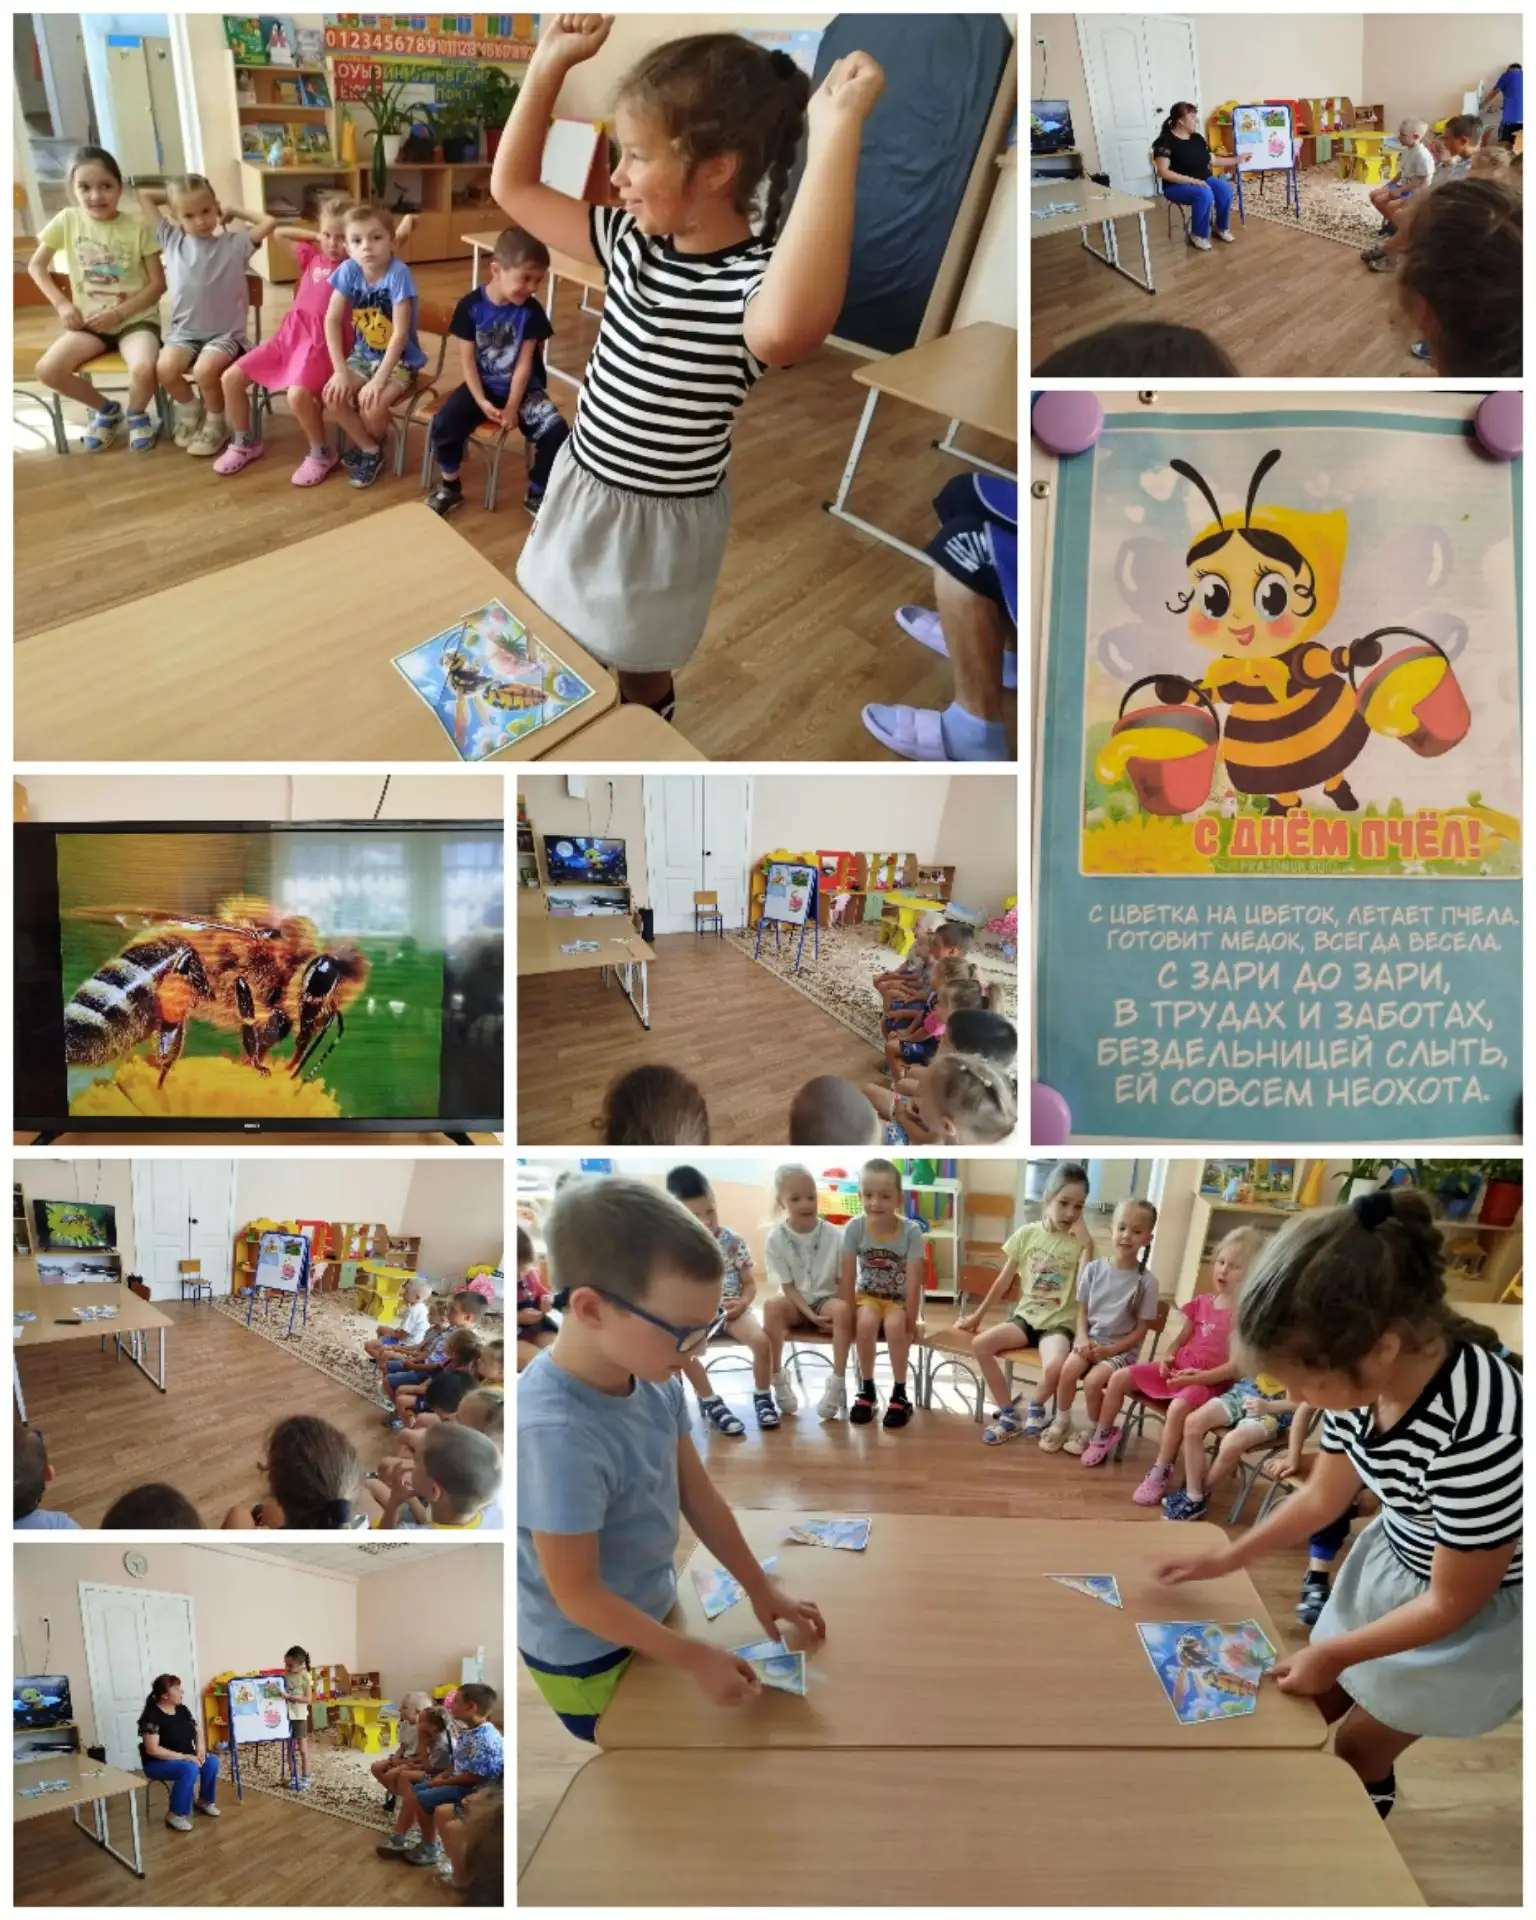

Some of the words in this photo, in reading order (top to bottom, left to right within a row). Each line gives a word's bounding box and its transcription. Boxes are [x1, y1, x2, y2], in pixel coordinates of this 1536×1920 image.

[1194, 817, 1220, 855] С
[1230, 809, 1349, 857] ДНЁМ
[1361, 810, 1481, 858] ПЧЁЛ!
[1088, 904, 1104, 924] С
[1110, 904, 1200, 925] ЦВЕТКА
[1206, 904, 1238, 925] НА
[1244, 904, 1340, 929] ЦВЕТОК,
[1347, 905, 1435, 926] ЛЕТАЕТ
[1441, 905, 1521, 926] ПЧЕЛА.
[1106, 929, 1214, 951] ГОТОВИТ
[1220, 930, 1305, 955] МЕДОК,
[1313, 930, 1401, 955] ВСЕГДА
[1157, 960, 1179, 990] С
[1190, 960, 1281, 992] ЗАРИ
[1292, 960, 1342, 995] ДО
[1353, 961, 1451, 995] ЗАРИ,
[1114, 998, 1139, 1028] В
[1150, 999, 1287, 1033] ТРУДАХ
[1299, 1001, 1322, 1030] И
[1334, 999, 1494, 1033] ЗАБОТАХ,
[1097, 1034, 1374, 1071] БЕЗДЕЛЬНИЦЕЙ
[1385, 1037, 1509, 1070] СЛЫТЬ,
[1115, 1071, 1157, 1105] ЕЙ
[1170, 1076, 1314, 1108] СОВСЕМ
[1326, 1075, 1492, 1108] НЕОХОТА.
